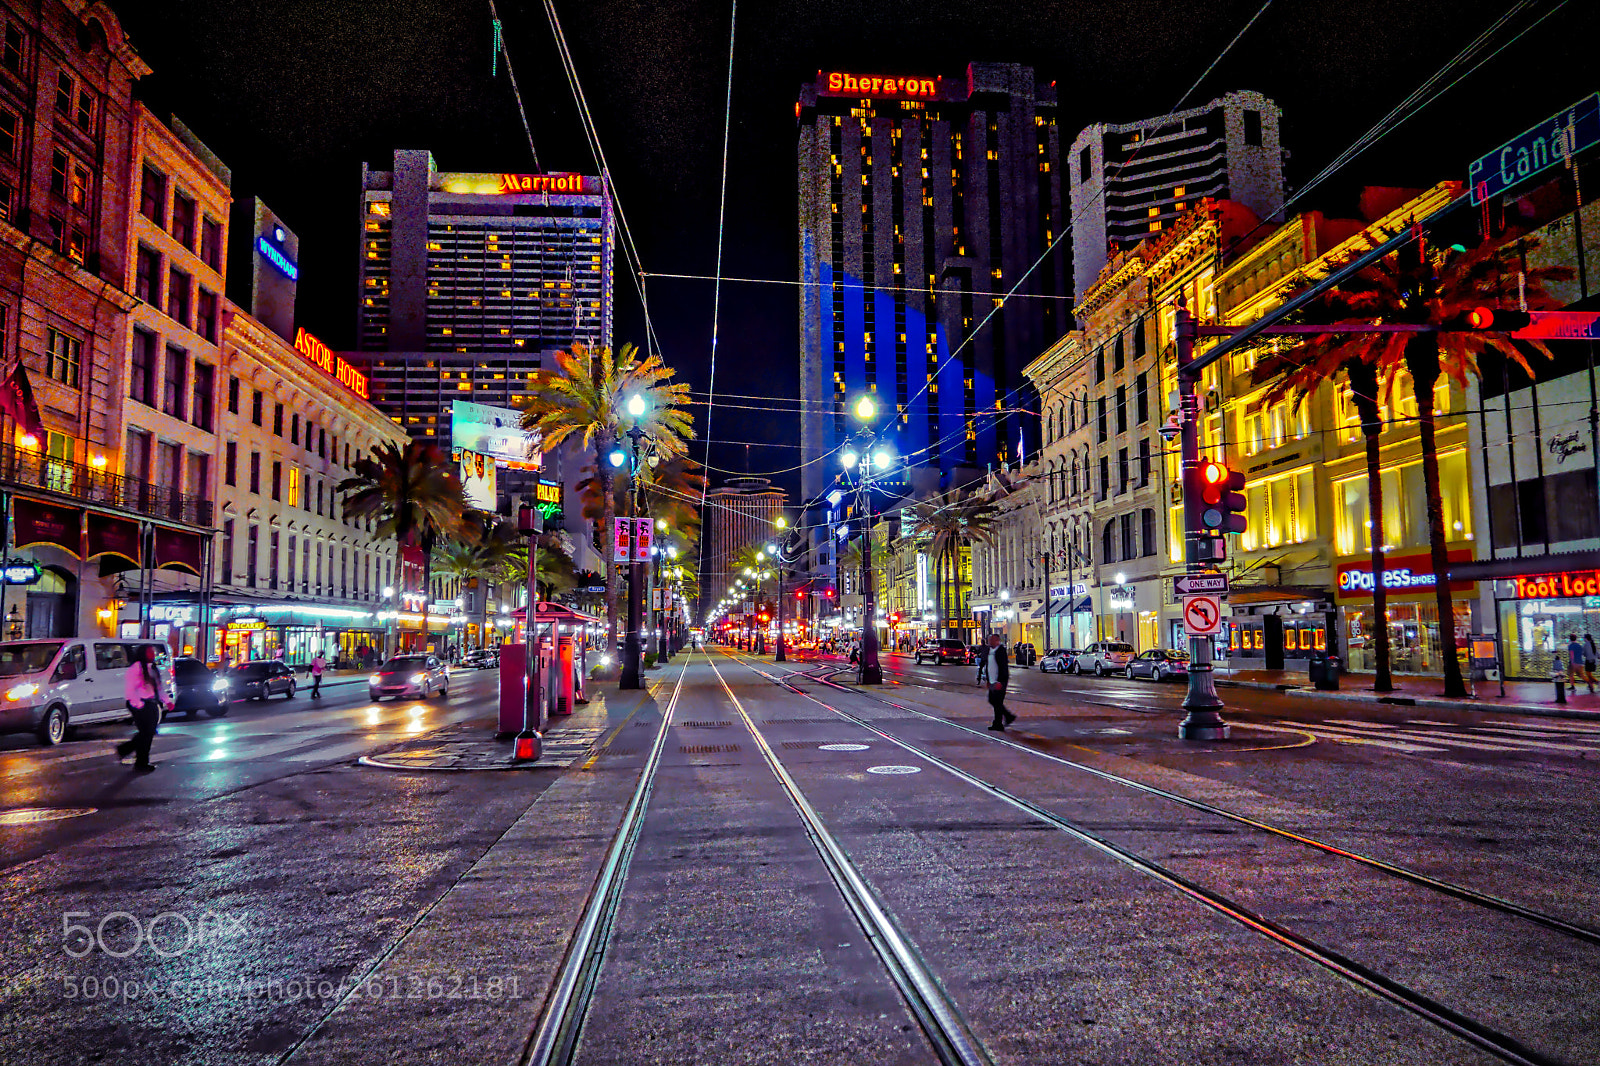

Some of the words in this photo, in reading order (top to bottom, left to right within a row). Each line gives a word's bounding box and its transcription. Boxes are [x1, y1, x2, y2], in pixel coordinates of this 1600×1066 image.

[828, 72, 936, 96] Sheraton
[1500, 108, 1576, 185] Canal
[499, 173, 583, 192] Marriott
[259, 237, 298, 280] WYNDHAM
[1531, 314, 1593, 337] ondelet
[294, 328, 334, 373] ASTOR
[336, 357, 369, 399] HOTEL
[537, 484, 560, 503] PALACE
[1189, 580, 1206, 589] ONE
[1206, 579, 1222, 588] WAY
[1350, 569, 1412, 591] Payess
[227, 622, 240, 631] VIN
